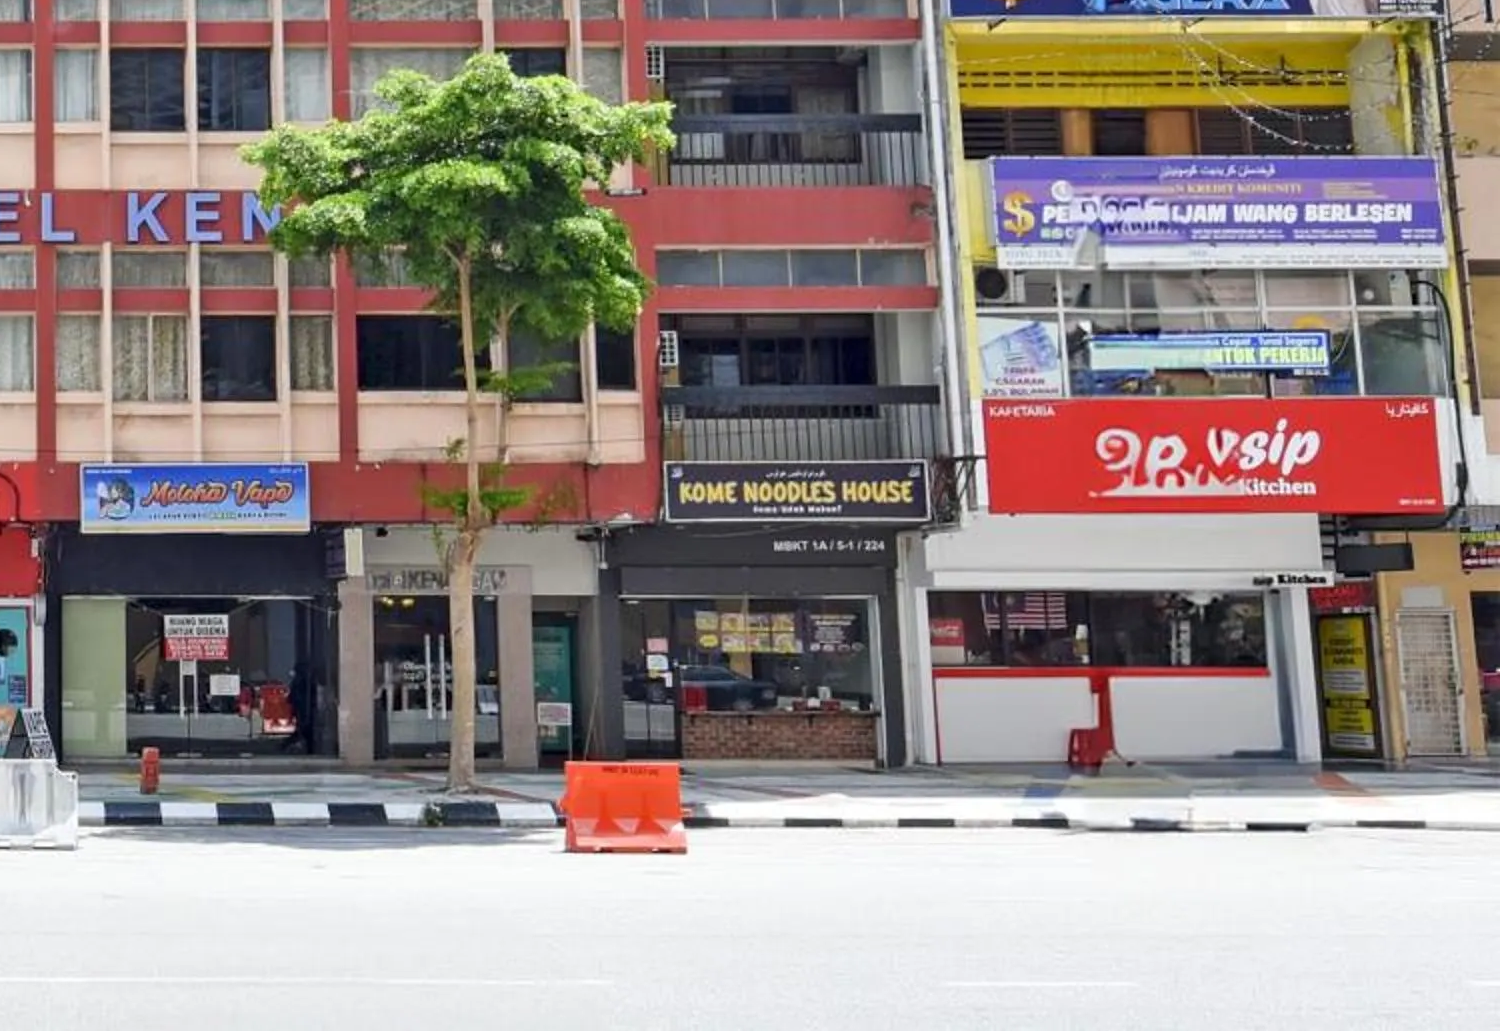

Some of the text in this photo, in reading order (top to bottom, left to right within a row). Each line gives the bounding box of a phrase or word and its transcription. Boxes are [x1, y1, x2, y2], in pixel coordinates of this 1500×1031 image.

[1233, 203, 1298, 224] WANG
[1304, 202, 1413, 223] BERLESEN
[989, 405, 1055, 418] KAFETARIA
[679, 480, 914, 504] KOME NOODLES HOUSE
[1242, 477, 1317, 496] Kitchen
[1277, 573, 1327, 585] Kitchen
